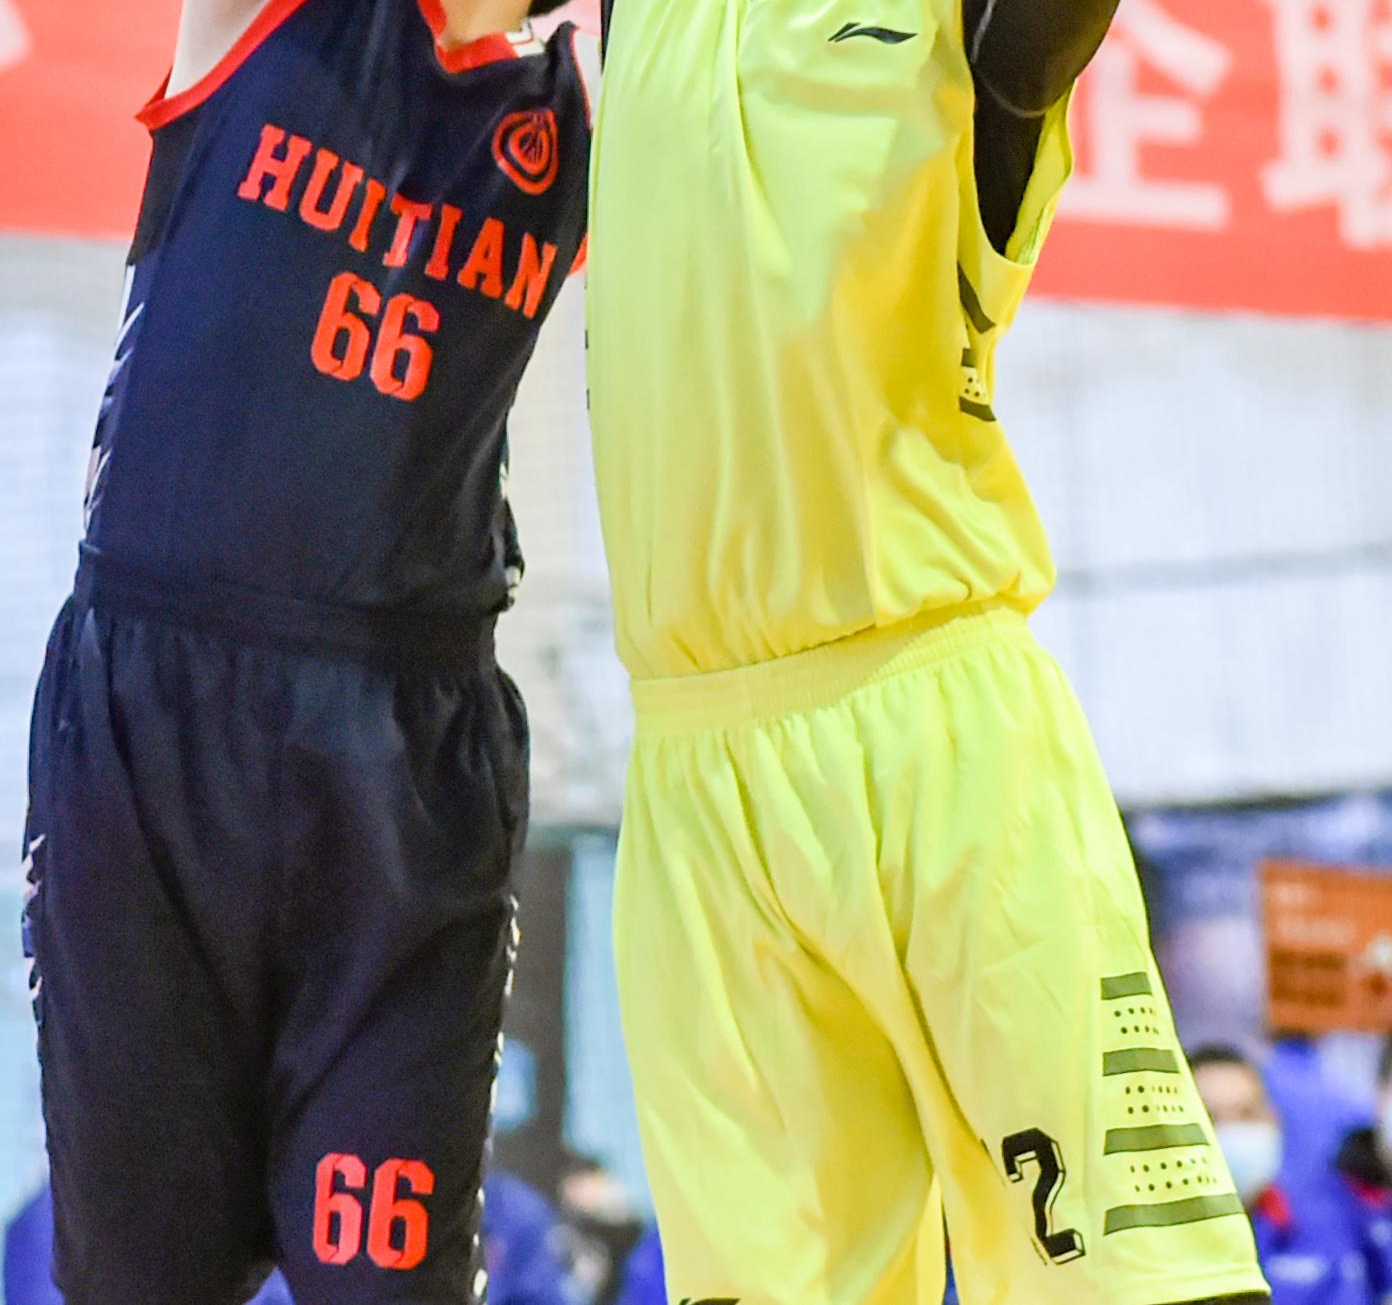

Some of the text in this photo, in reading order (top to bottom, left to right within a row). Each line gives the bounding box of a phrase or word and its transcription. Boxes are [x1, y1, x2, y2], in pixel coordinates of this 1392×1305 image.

[237, 123, 557, 320] HUITIAN
[311, 271, 440, 401] 66
[312, 1152, 434, 1270] 66
[1001, 1127, 1086, 1266] 2
